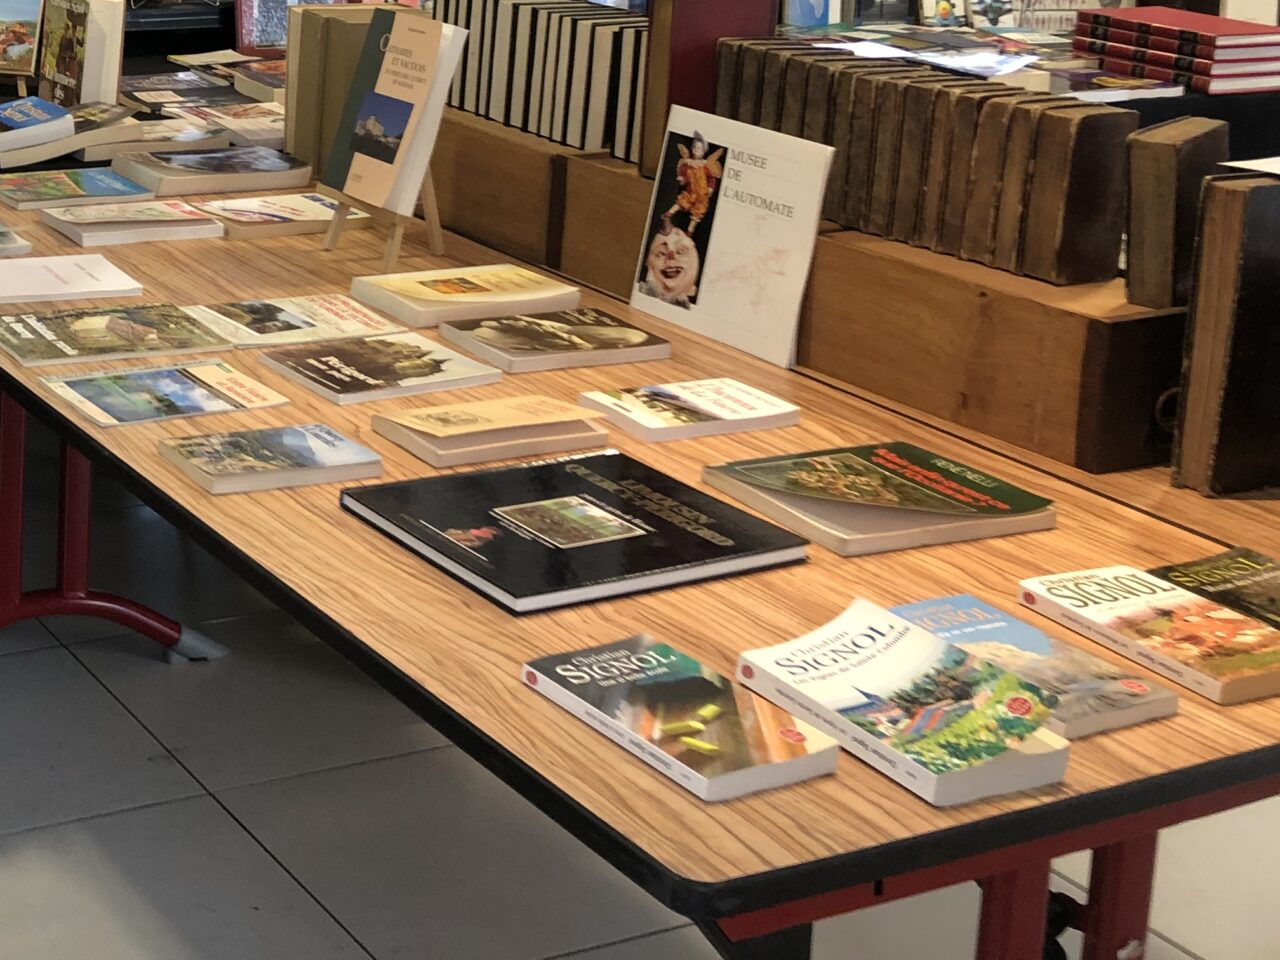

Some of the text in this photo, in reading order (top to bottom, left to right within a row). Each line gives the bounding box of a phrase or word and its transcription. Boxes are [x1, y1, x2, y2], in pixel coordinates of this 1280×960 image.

[731, 149, 768, 169] MUSEE
[727, 167, 742, 182] DE
[723, 186, 794, 218] L'AUTOMATE
[1169, 557, 1274, 587] SIGNOL
[1047, 573, 1178, 608] SIGNOL
[571, 649, 632, 665] Christian
[774, 623, 895, 676] SIGNOL
[791, 630, 849, 658] Christian
[555, 650, 677, 685] SIGNOL
